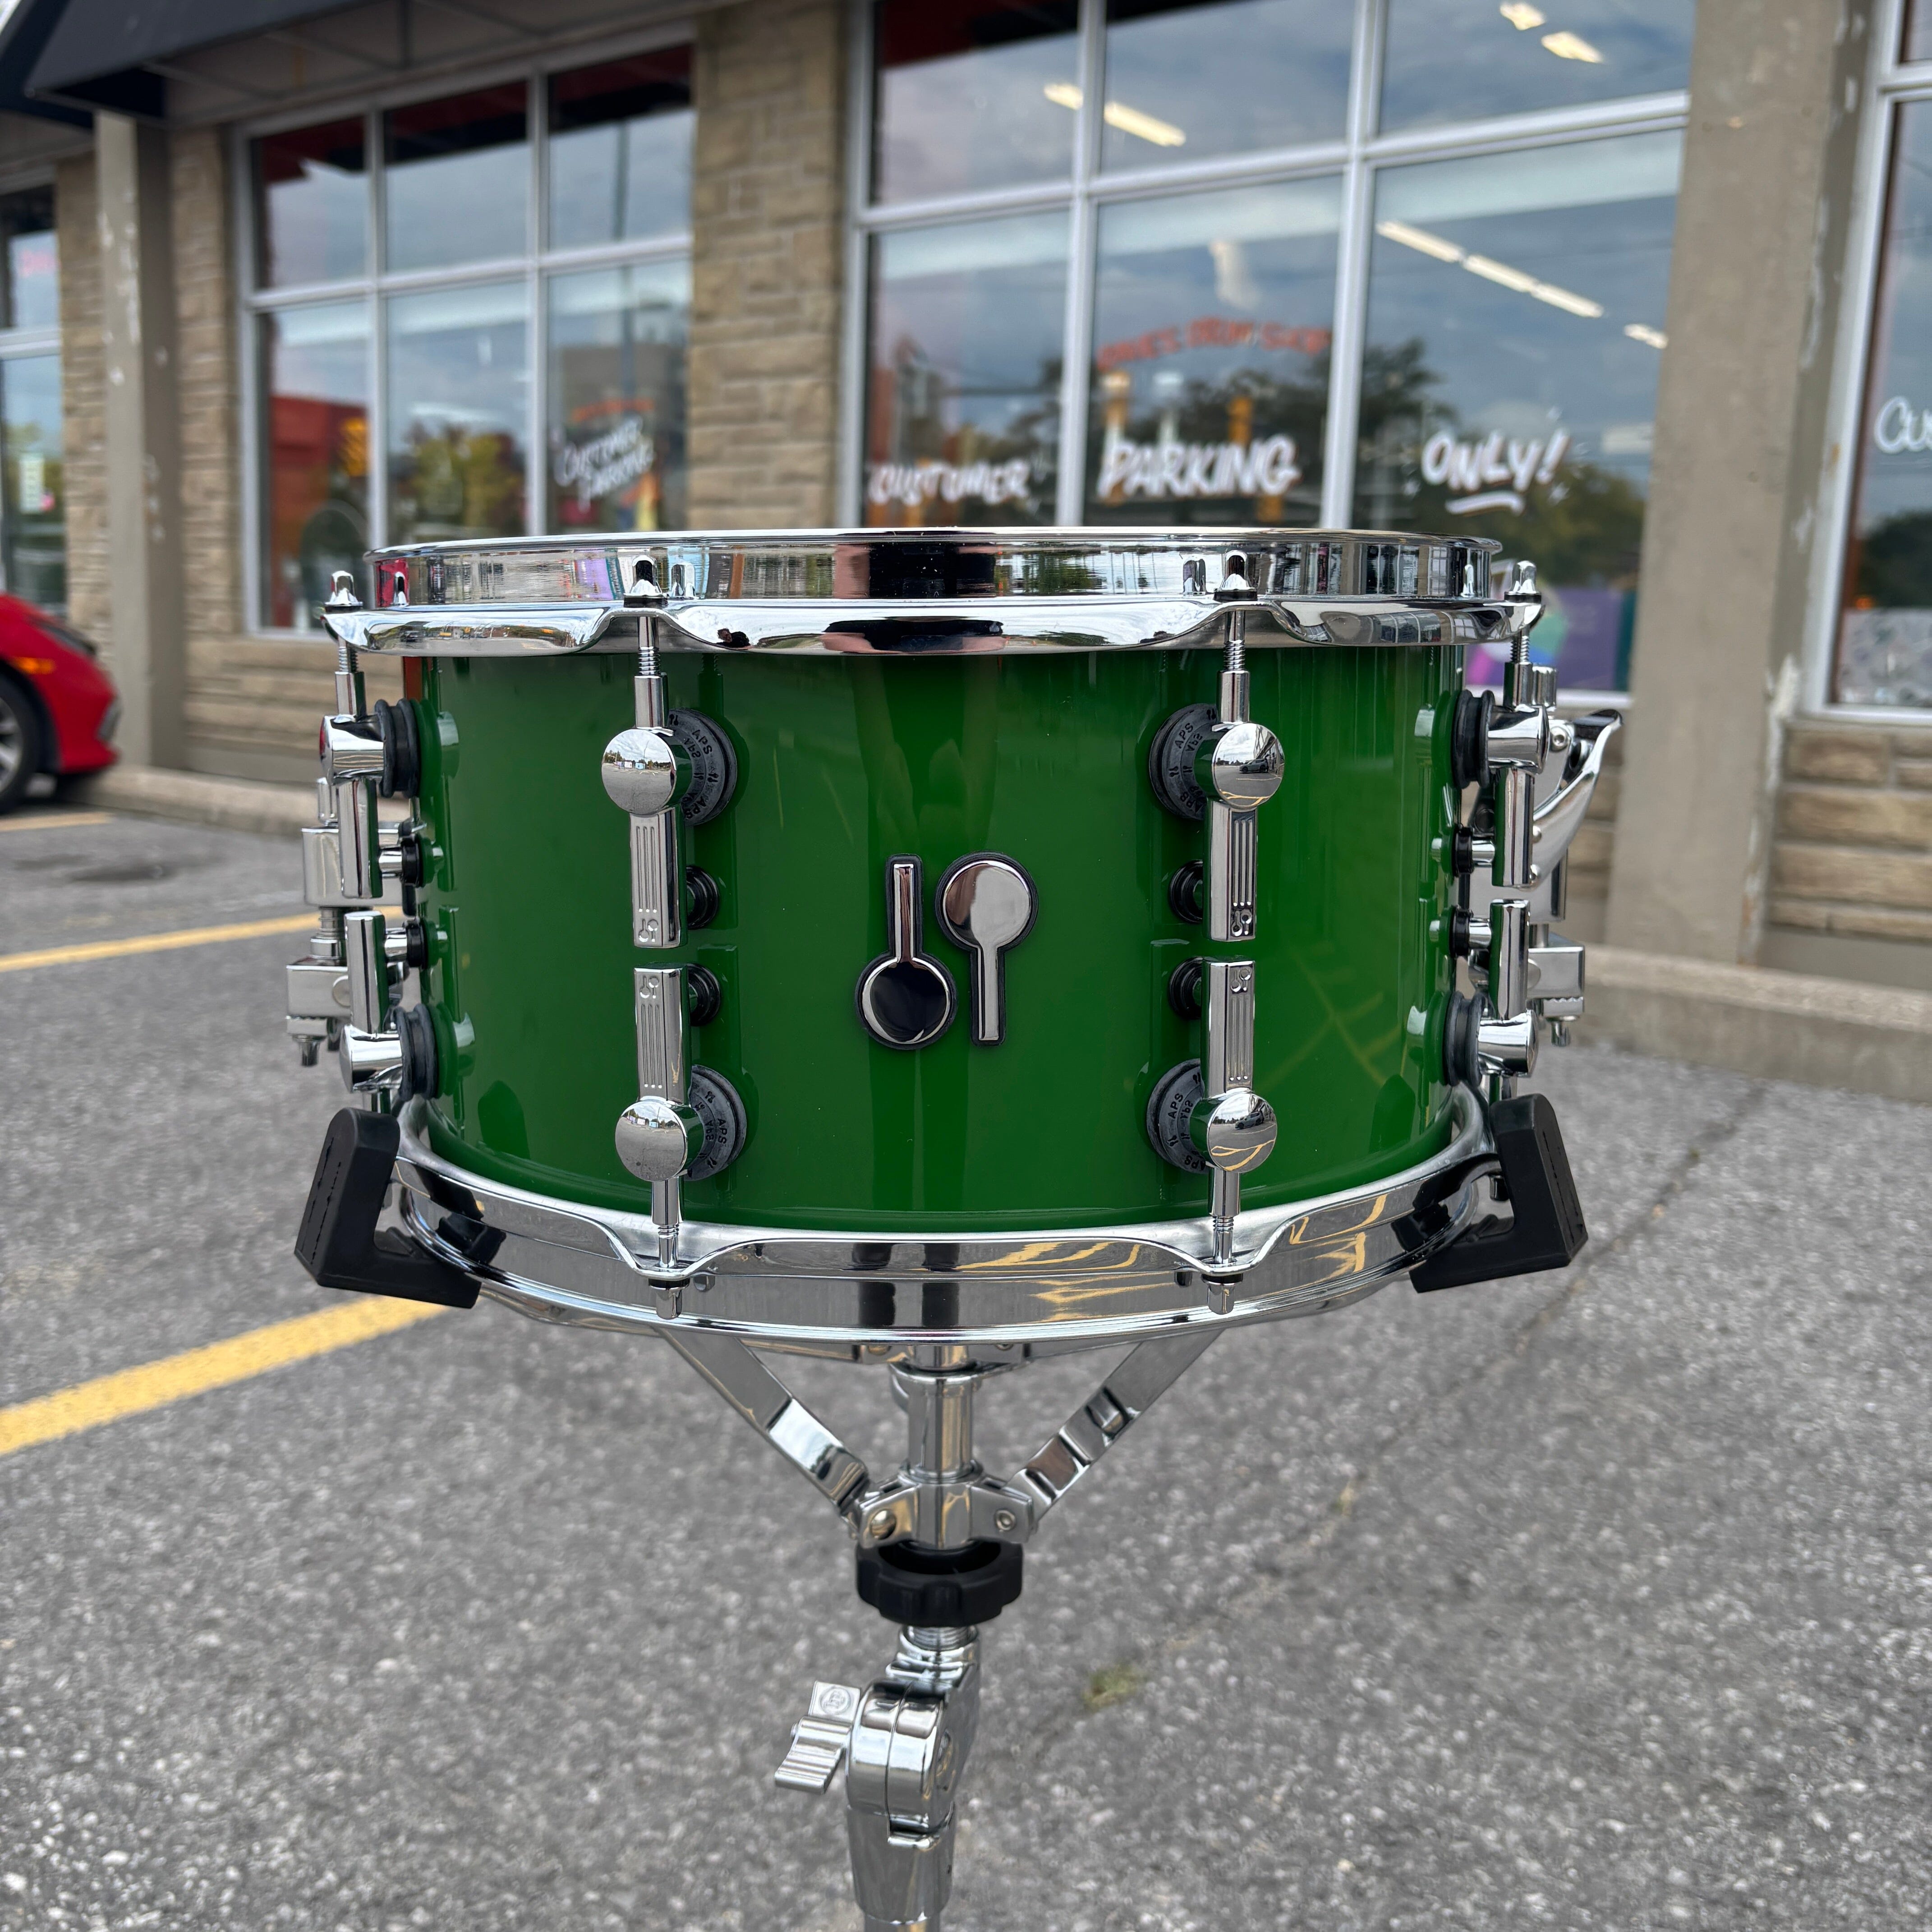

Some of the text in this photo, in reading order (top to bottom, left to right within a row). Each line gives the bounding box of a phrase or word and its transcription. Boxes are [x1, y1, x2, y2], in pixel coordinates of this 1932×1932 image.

[868, 428, 1570, 505] CUSTOMER PARKING ONLY!
[692, 729, 713, 755] APS
[1174, 722, 1194, 749] APS
[1168, 1093, 1183, 1120] APS
[718, 1118, 727, 1145] APS
